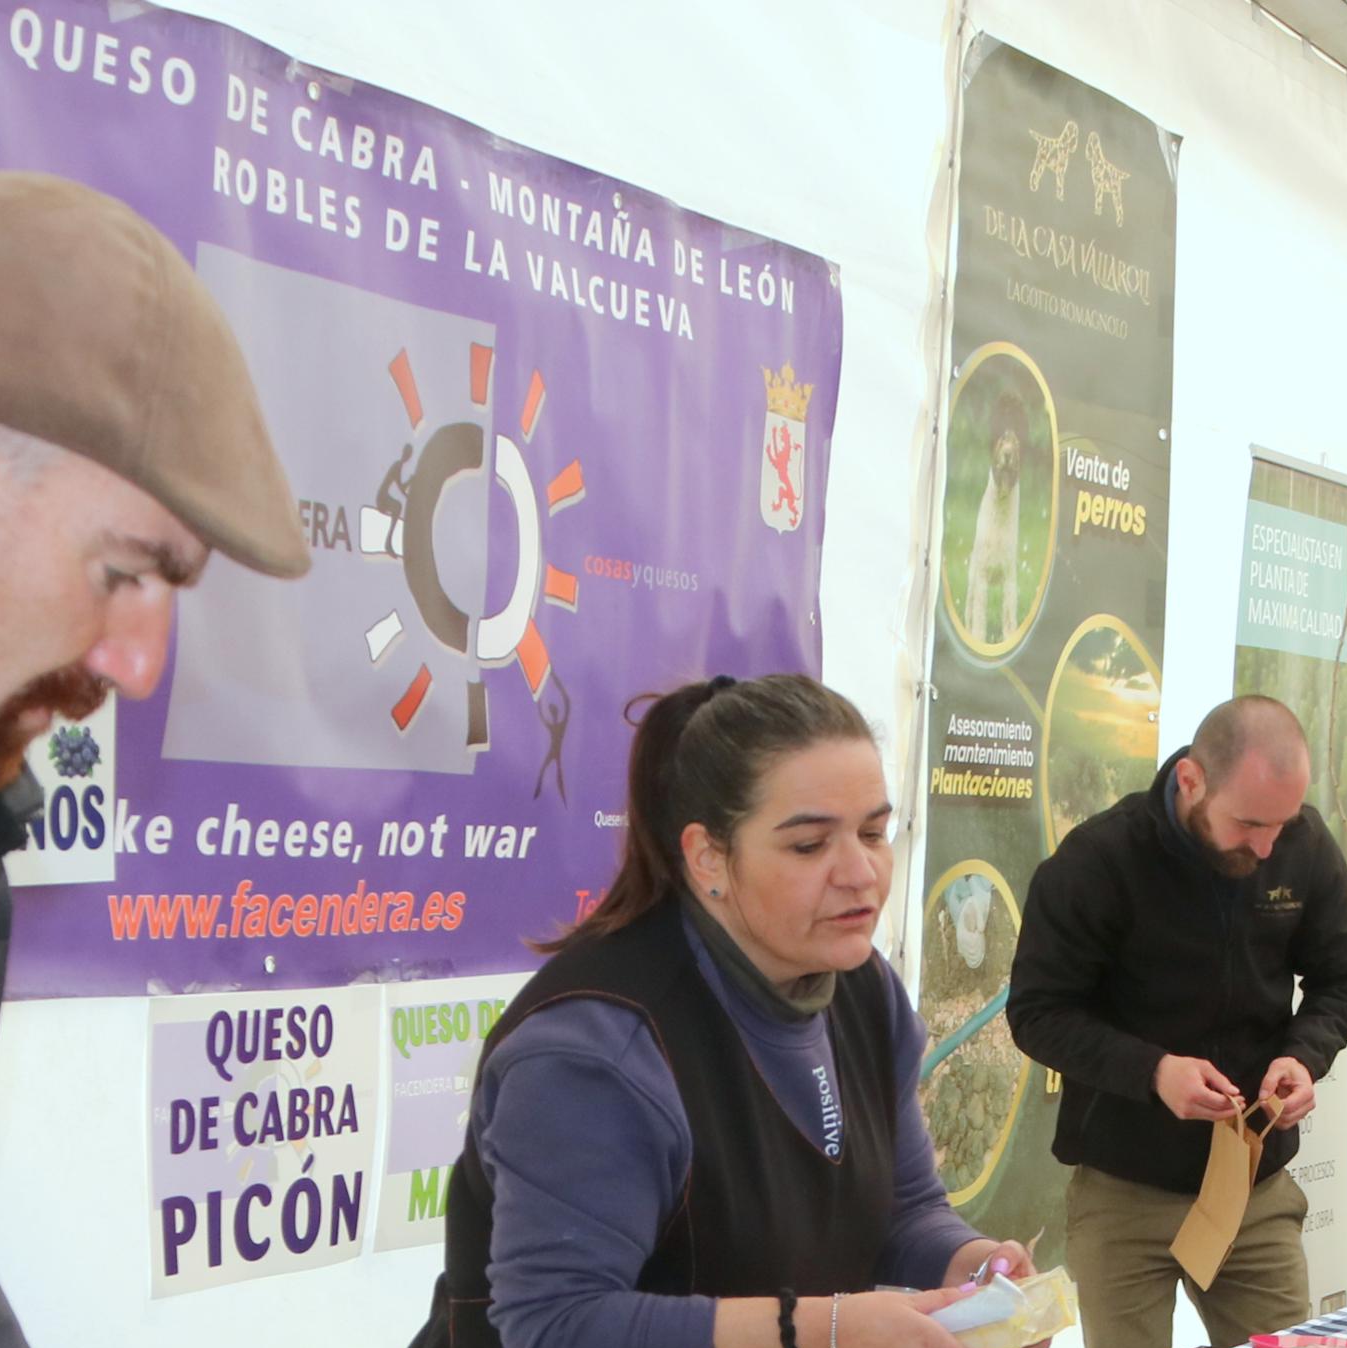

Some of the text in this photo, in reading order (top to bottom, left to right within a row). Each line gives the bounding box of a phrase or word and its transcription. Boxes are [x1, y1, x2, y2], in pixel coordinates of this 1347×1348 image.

[10, 8, 197, 106] QUESO
[226, 74, 269, 136] DE
[291, 106, 438, 190] CABRA
[488, 171, 656, 268] MONTAÑA
[674, 238, 704, 285] DE
[720, 259, 795, 314] LEÓN
[213, 146, 694, 340] ROBLES DE LA VALCUEVA
[984, 205, 1007, 242] DE
[1011, 214, 1032, 260] LA
[1033, 225, 1077, 278] CASA
[1006, 277, 1058, 316] LAGOTTO
[1066, 446, 1130, 491] Venta de
[1073, 489, 1147, 536] perros
[1251, 523, 1343, 570] ESPECIALISTAS EN
[1249, 560, 1309, 598] PLANTA DE
[1247, 597, 1343, 640] MAXIMA CALIDAD
[943, 741, 1035, 767] mantenimiento
[947, 713, 1033, 742] Asesoramiento
[929, 766, 1034, 800] Plantaciones
[114, 798, 538, 863] ke cheese, not war
[106, 879, 468, 941] www.facendera.es
[206, 1003, 334, 1082] QUESO
[391, 1000, 471, 1060] QUESO
[394, 1076, 453, 1098] FACENDERA
[812, 1065, 841, 1157] positive
[170, 1083, 359, 1155] DE CABRA
[161, 1152, 364, 1277] PICÓN
